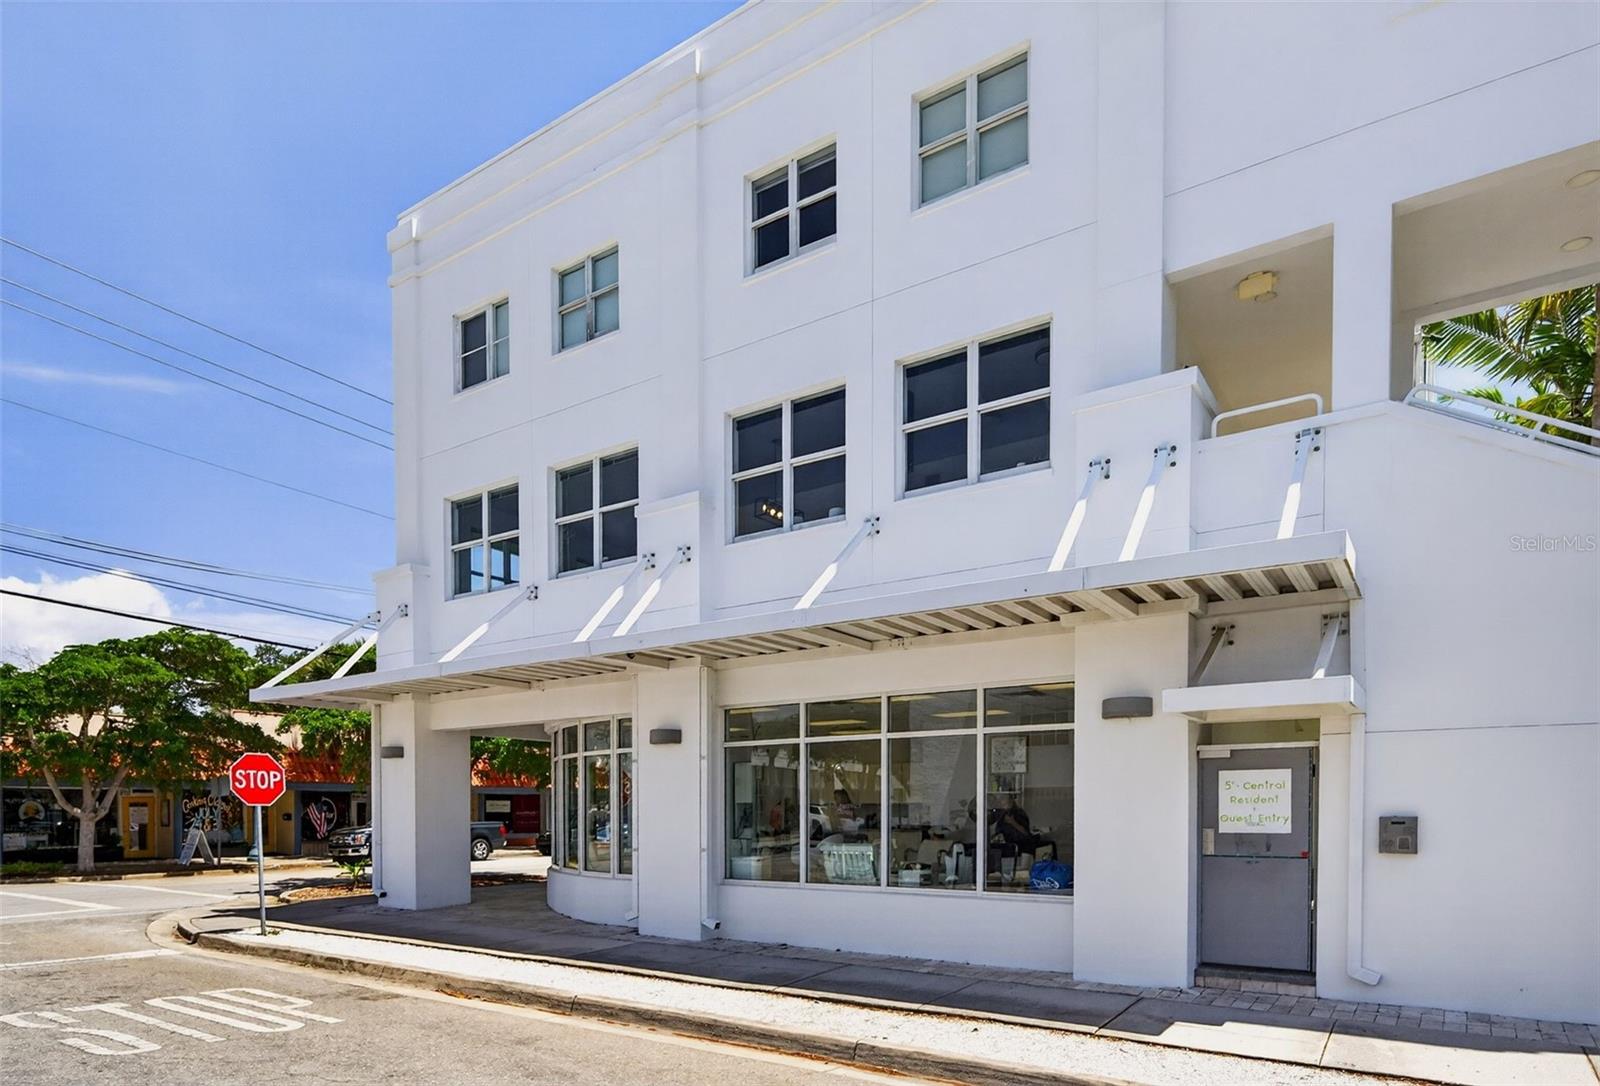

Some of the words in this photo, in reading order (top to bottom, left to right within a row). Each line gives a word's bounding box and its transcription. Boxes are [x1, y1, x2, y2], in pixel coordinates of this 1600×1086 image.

[234, 769, 281, 789] STOP
[1243, 780, 1286, 790] Central
[1230, 794, 1279, 804] Resident
[1258, 813, 1290, 825] Entry
[0, 988, 345, 1055] STOP
